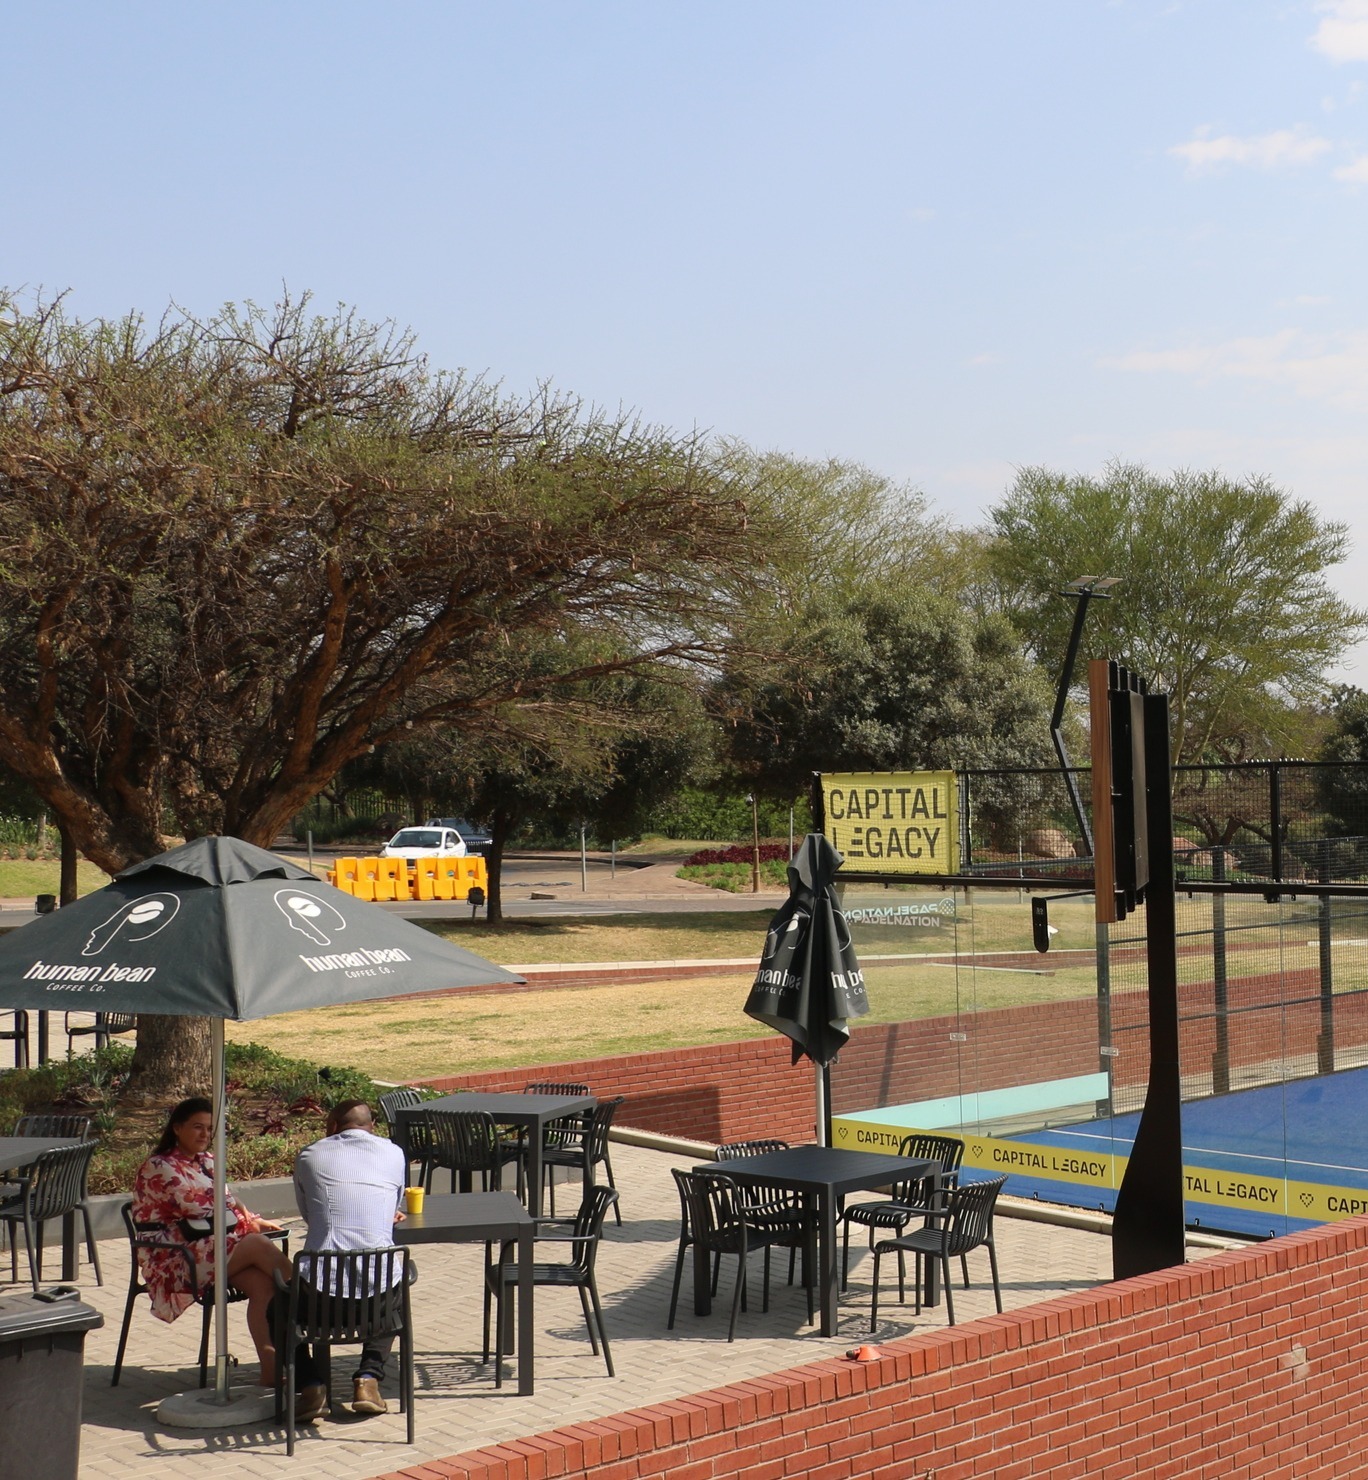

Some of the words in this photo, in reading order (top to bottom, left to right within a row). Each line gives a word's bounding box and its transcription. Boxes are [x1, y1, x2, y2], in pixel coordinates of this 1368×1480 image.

[830, 788, 947, 819] CAPITAL
[832, 827, 940, 858] LEGACY
[23, 960, 102, 982] human
[99, 963, 157, 982] bean
[298, 951, 371, 972] human
[359, 947, 412, 965] bean
[993, 1148, 1048, 1169] CAPITAL
[1053, 1157, 1106, 1177] LEGACY
[1217, 1181, 1278, 1203] LEGACY
